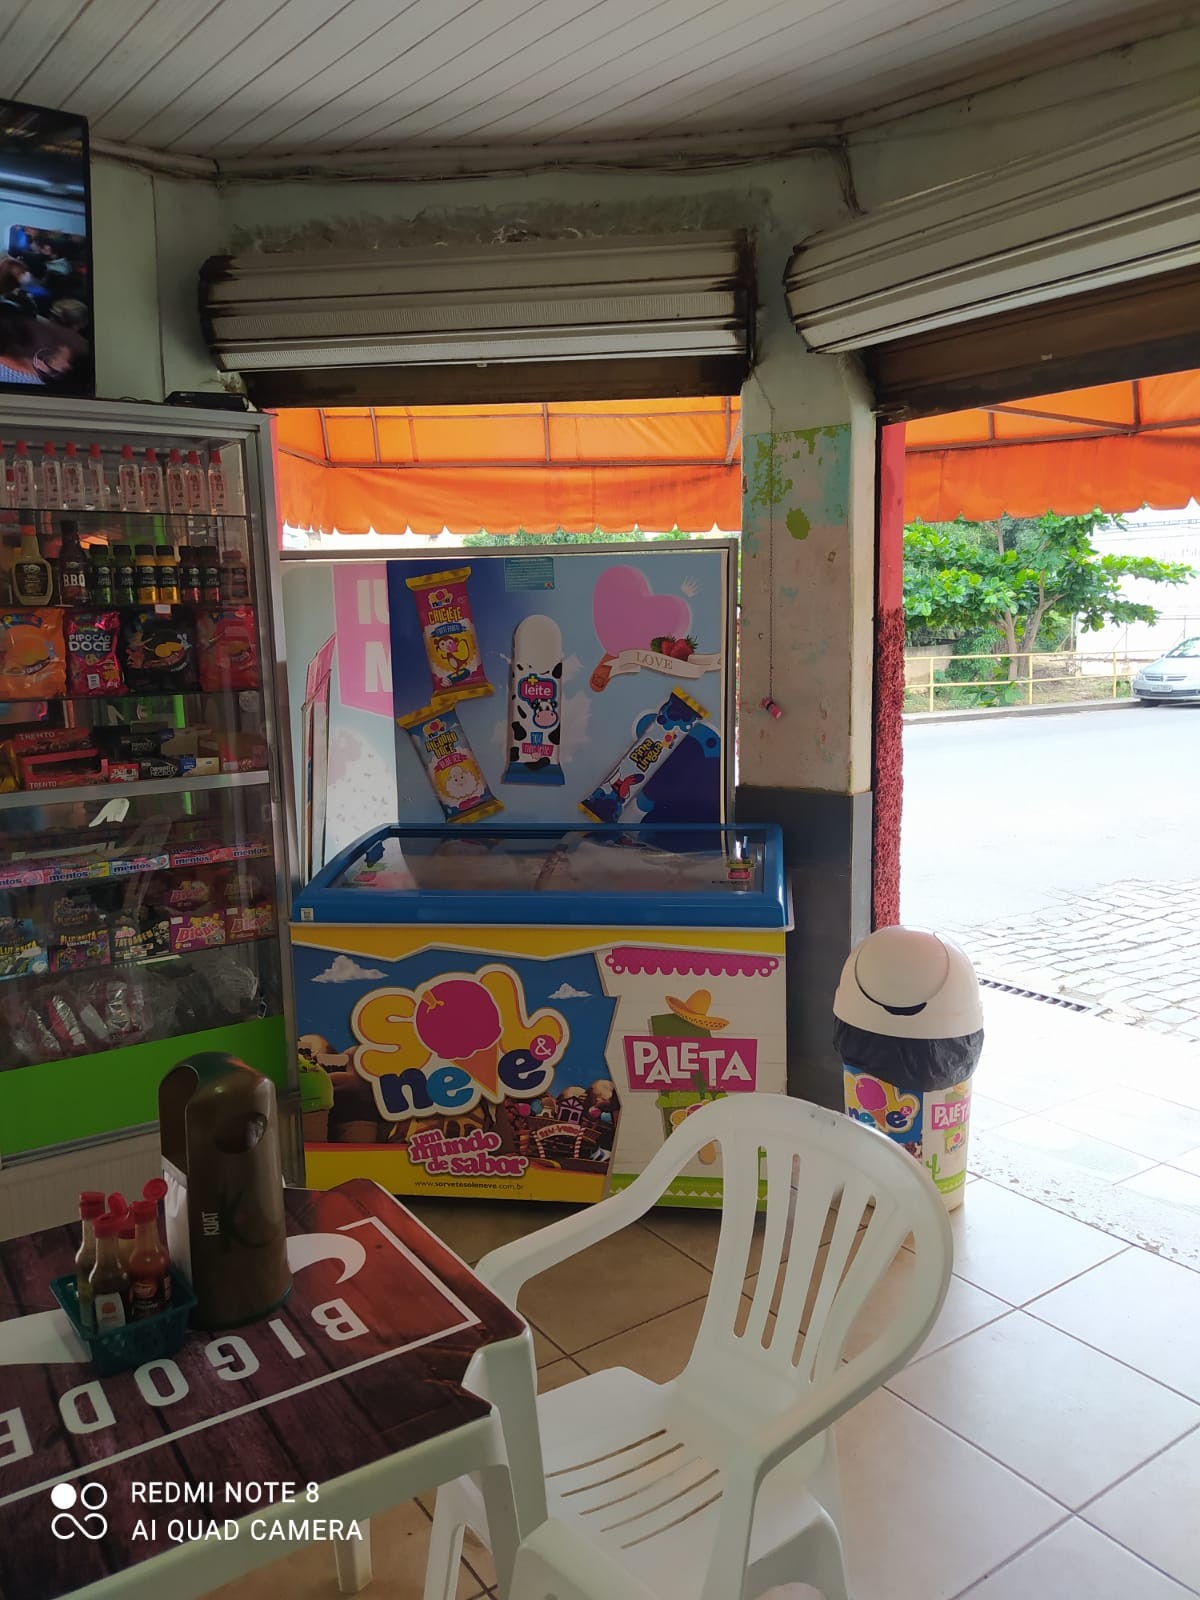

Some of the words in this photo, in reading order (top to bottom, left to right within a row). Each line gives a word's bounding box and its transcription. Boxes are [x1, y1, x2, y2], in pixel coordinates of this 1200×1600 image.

[64, 573, 86, 588] BBQ
[428, 606, 464, 625] CHICLETE
[69, 642, 112, 652] DOCE
[636, 652, 673, 670] LOVE
[525, 684, 552, 697] leite
[29, 780, 57, 790] TRENTO
[233, 847, 267, 857] mentos
[175, 854, 210, 865] mentos
[113, 861, 152, 873] mentos
[49, 870, 90, 881] mentos
[632, 1040, 753, 1086] PALETA
[412, 1129, 443, 1145] um
[412, 1130, 501, 1161] mundo
[427, 1156, 449, 1172] de
[450, 1153, 528, 1176] sabor
[414, 1180, 524, 1191] www.sorvetesoleneve.com.br
[203, 1211, 221, 1237] KUAT
